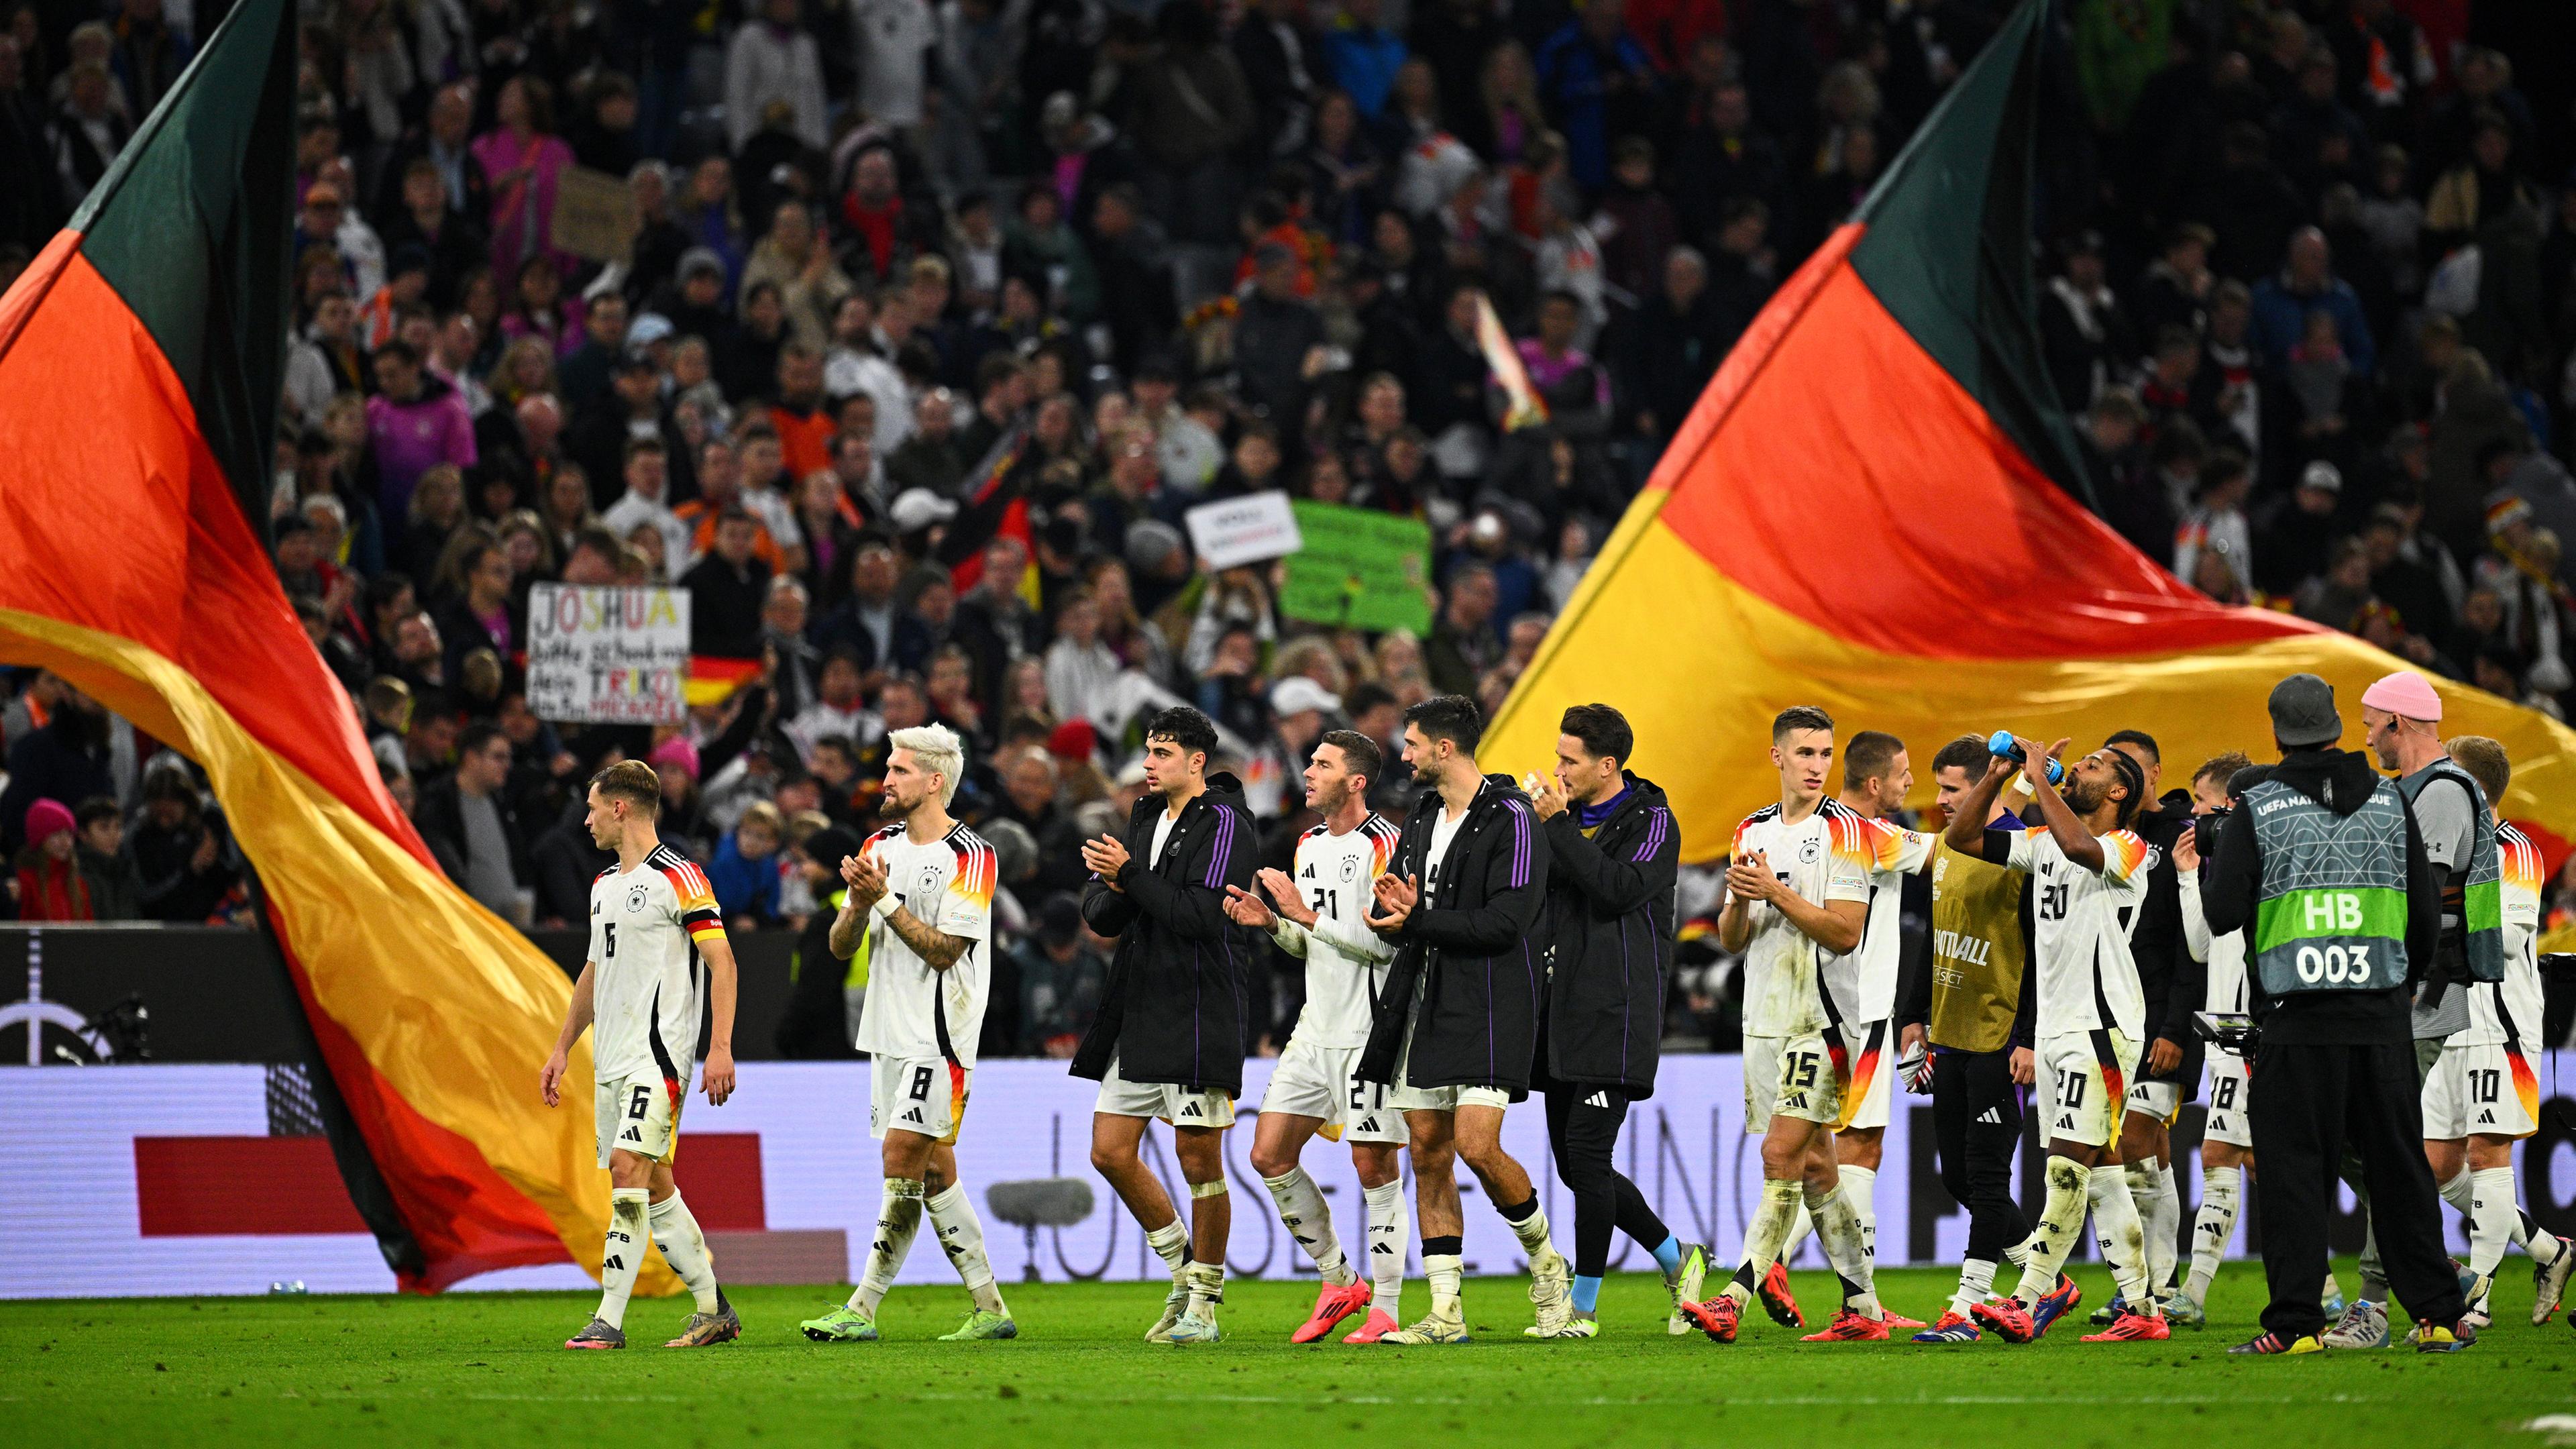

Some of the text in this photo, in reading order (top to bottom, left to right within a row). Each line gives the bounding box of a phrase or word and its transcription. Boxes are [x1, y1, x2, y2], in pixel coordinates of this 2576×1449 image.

[535, 587, 677, 637] JOSHUA
[2257, 798, 2289, 816] UEFA
[2040, 883, 2070, 922] 20
[2304, 894, 2363, 930] HB
[604, 922, 616, 959] 6
[2296, 945, 2371, 983] 003
[909, 1066, 934, 1103] 8
[1786, 1051, 1821, 1089] 15
[2468, 1069, 2500, 1105] 10
[629, 1085, 652, 1122] 6
[1350, 1074, 1384, 1111] 21
[2056, 1069, 2088, 1111] 20
[2210, 1075, 2239, 1112] 18
[938, 1226, 959, 1235] FB
[2039, 1220, 2060, 1234] FB
